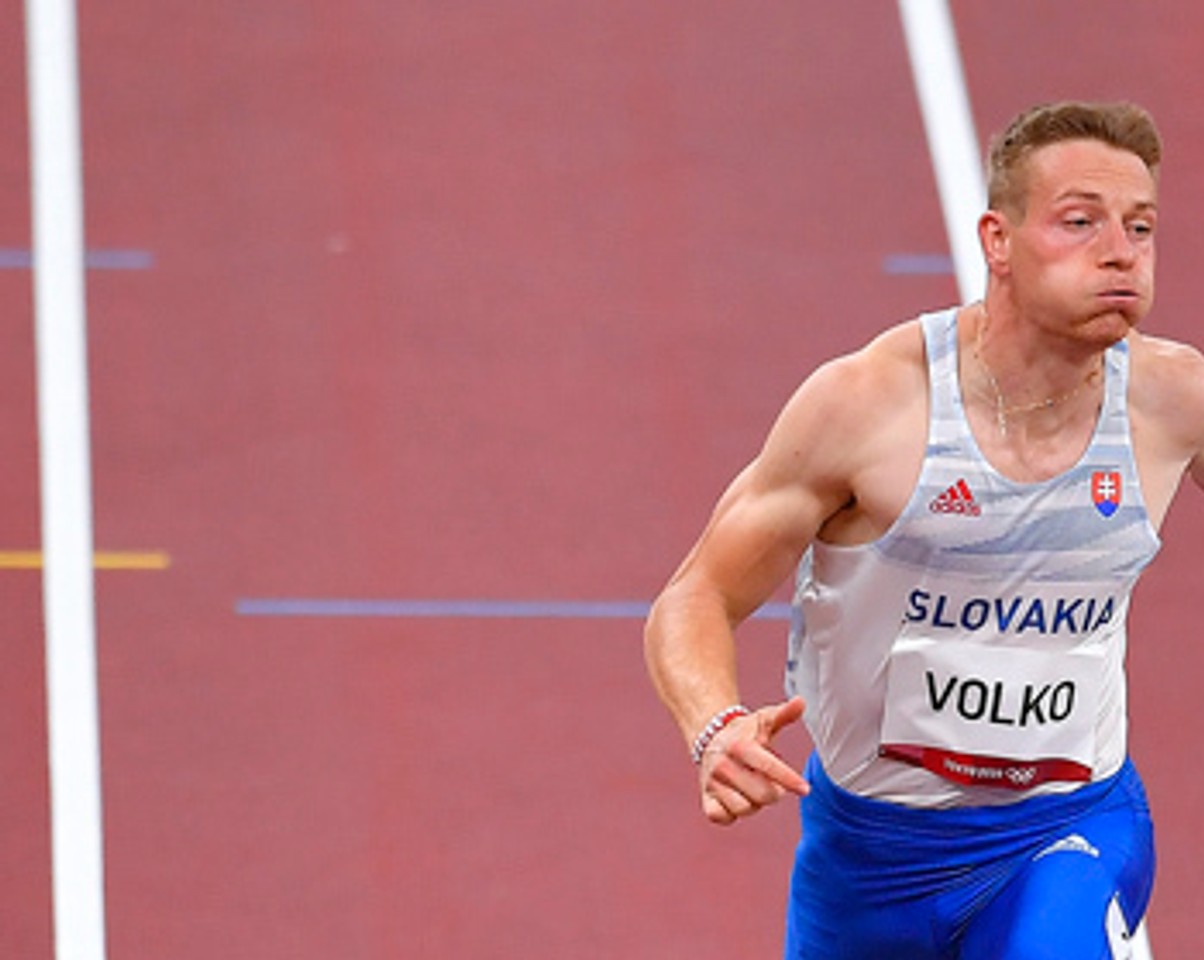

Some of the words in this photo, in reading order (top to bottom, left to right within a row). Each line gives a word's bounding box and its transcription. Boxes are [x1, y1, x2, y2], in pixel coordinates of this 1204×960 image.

[929, 500, 982, 517] adidas
[904, 588, 1114, 634] SLOVAKIA
[926, 671, 1075, 727] VOLKO
